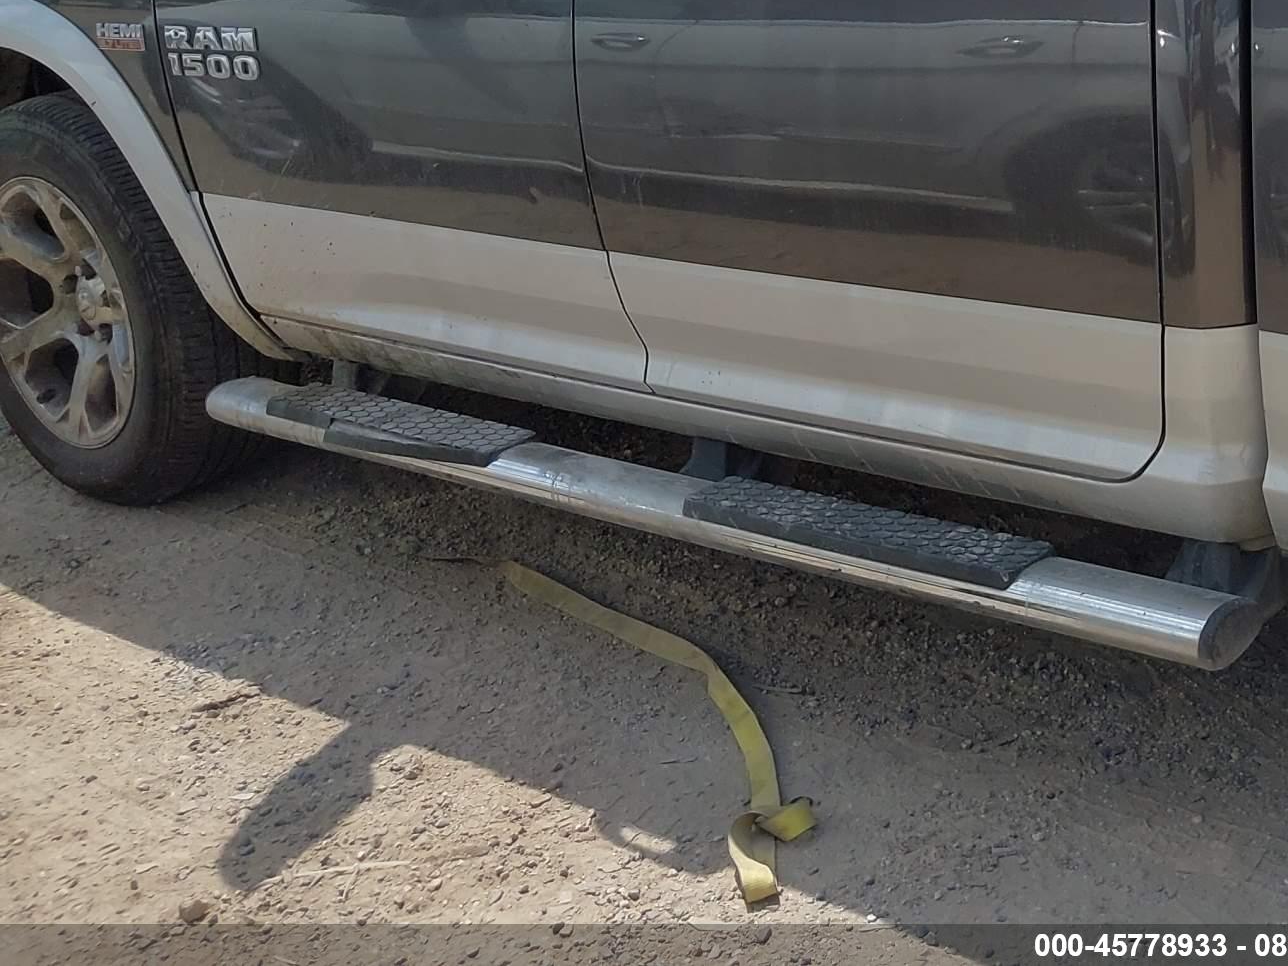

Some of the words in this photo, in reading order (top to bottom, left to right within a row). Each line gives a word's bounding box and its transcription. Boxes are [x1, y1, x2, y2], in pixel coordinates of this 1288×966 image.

[95, 23, 143, 38] HEMI
[164, 25, 257, 51] RAM
[167, 52, 259, 81] 1500
